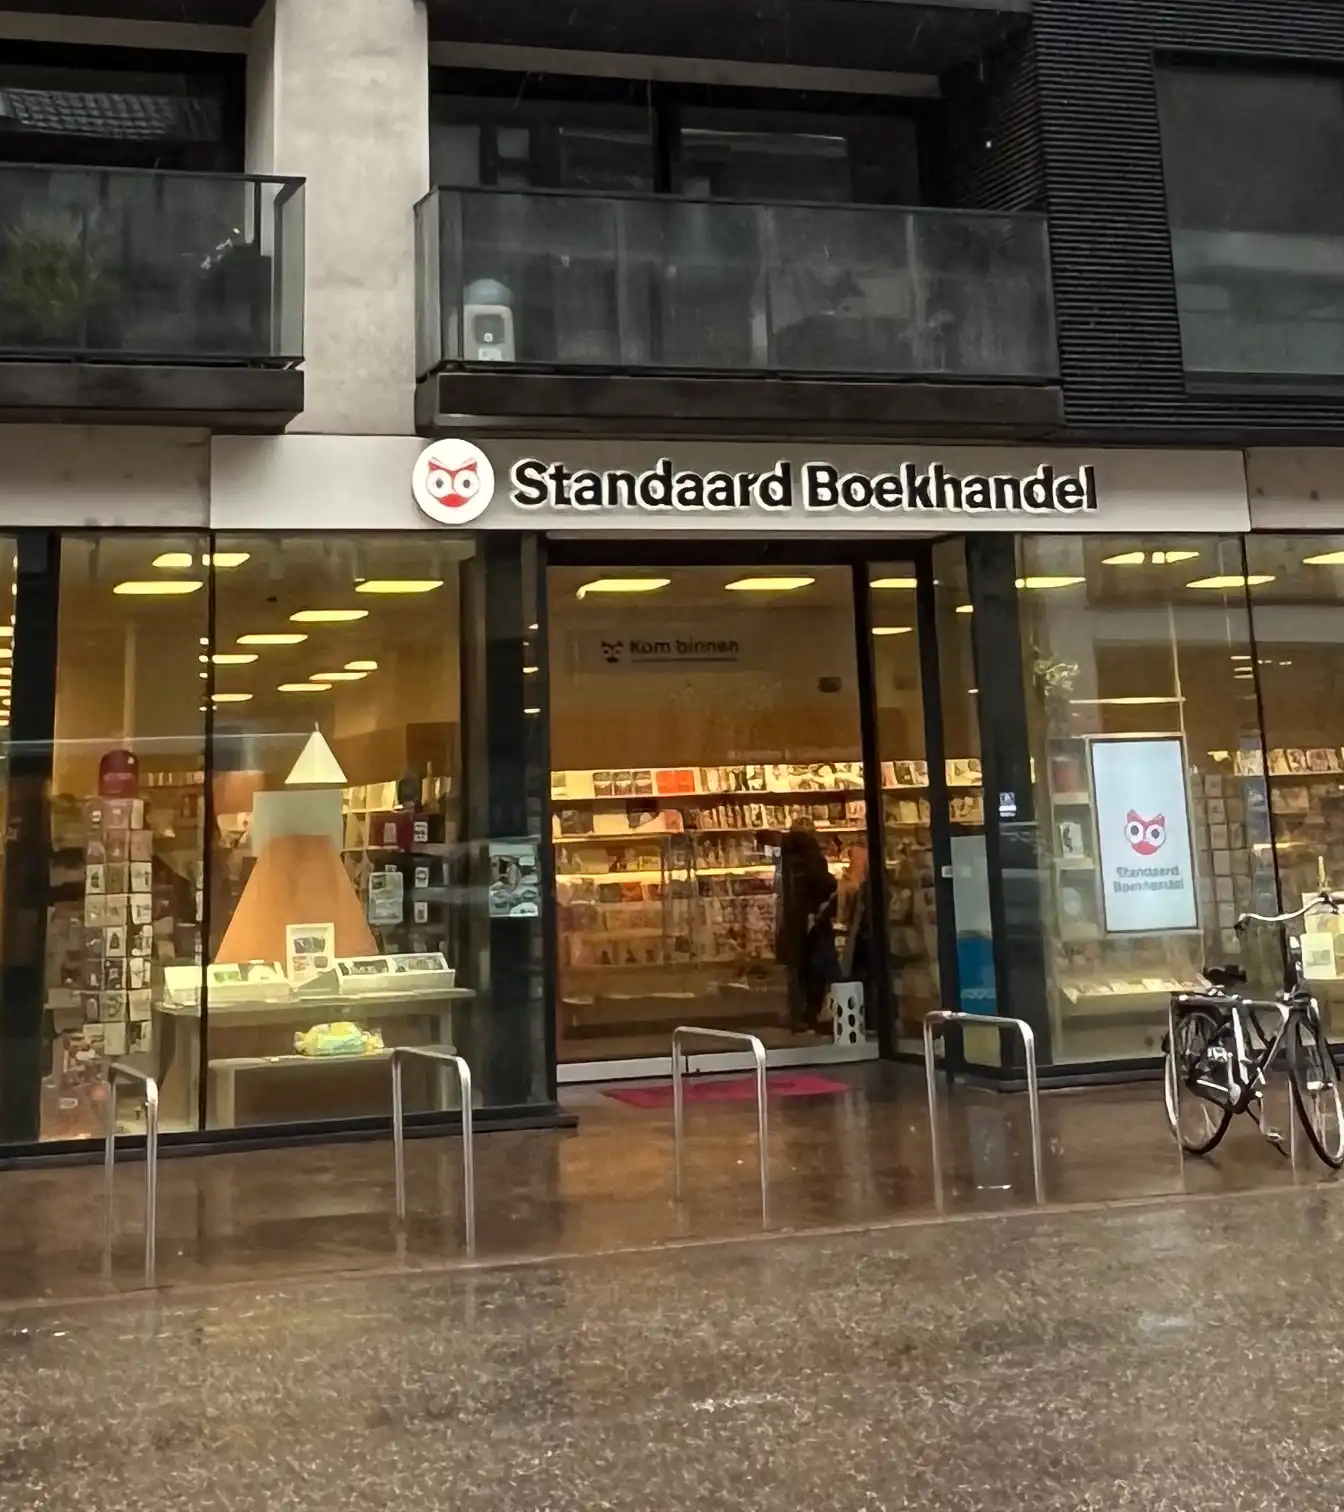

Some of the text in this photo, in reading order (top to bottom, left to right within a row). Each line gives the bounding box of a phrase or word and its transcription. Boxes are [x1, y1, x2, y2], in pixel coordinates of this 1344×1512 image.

[509, 457, 1098, 513] Standaard Boekhandel
[629, 640, 671, 653] Kom
